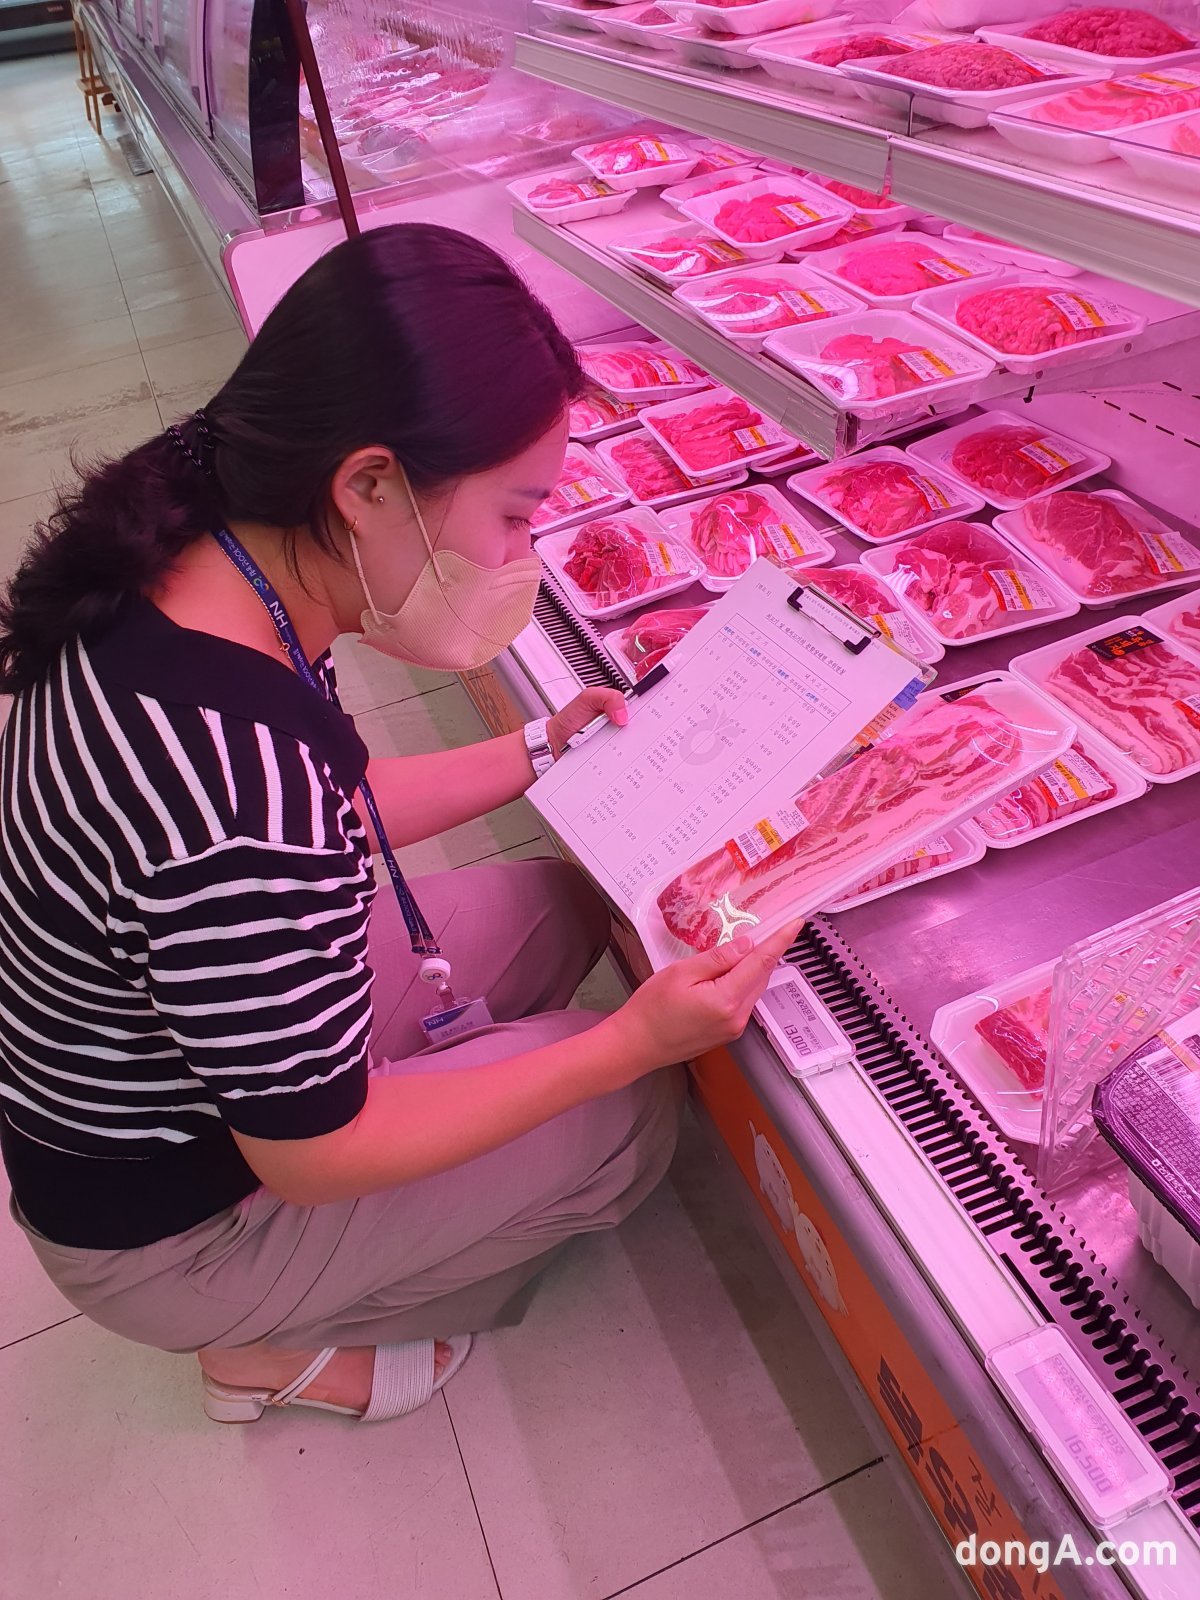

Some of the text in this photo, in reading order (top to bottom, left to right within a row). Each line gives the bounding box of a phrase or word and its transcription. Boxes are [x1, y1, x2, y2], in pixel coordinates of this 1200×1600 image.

[269, 600, 288, 628] NH
[784, 1024, 812, 1056] 13,000
[1064, 1434, 1113, 1494] 16,500
